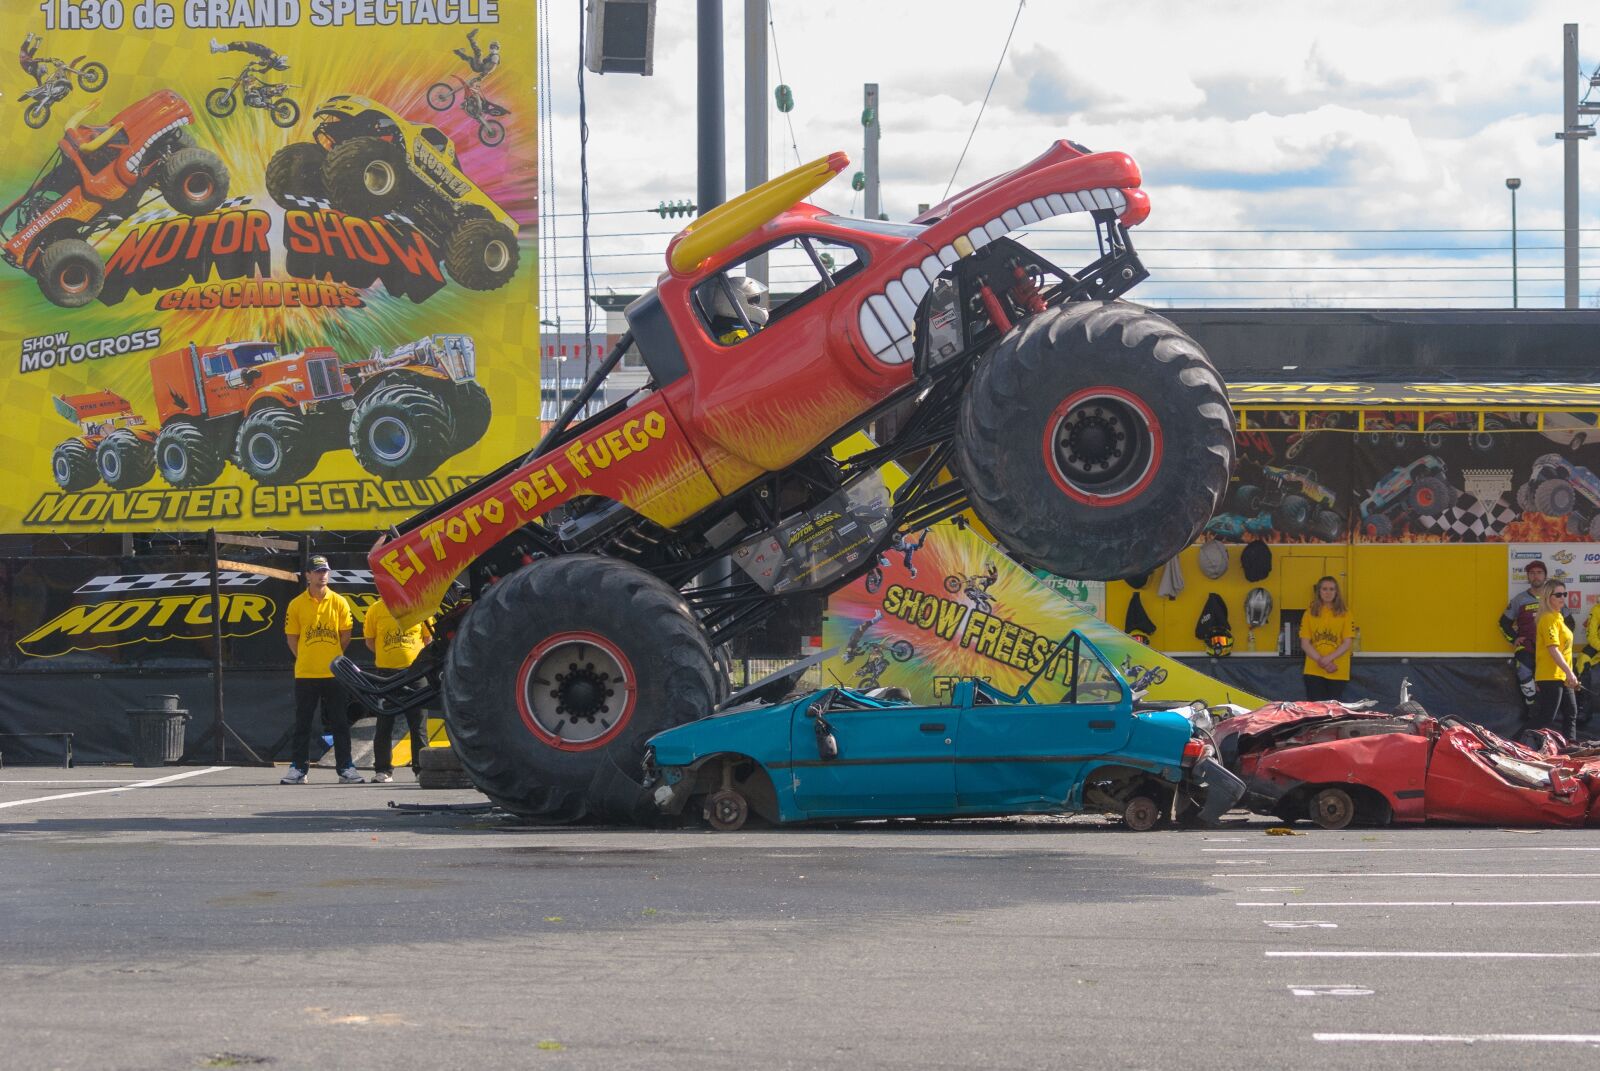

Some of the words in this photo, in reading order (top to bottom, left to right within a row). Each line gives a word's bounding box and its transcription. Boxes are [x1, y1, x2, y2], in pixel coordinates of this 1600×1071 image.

[41, 0, 124, 30] 1h30
[134, 0, 175, 29] de
[184, 0, 302, 28] GRAND
[309, 0, 500, 26] SPECTACLE
[21, 224, 39, 241] TORO
[37, 214, 53, 229] DEL
[50, 197, 73, 218] FUEGO
[104, 209, 271, 279] MOTOR
[288, 208, 443, 284] SHOW
[159, 280, 366, 309] CASCADEURS
[20, 328, 162, 374] MOTOCROSS
[21, 331, 70, 353] SHOW
[25, 486, 242, 524] MONSTER
[253, 476, 484, 516] SPECTACUL
[788, 523, 815, 548] MOTOR
[815, 512, 843, 528] SHOW
[20, 595, 267, 645] MOTOR
[882, 583, 966, 641] SHOW
